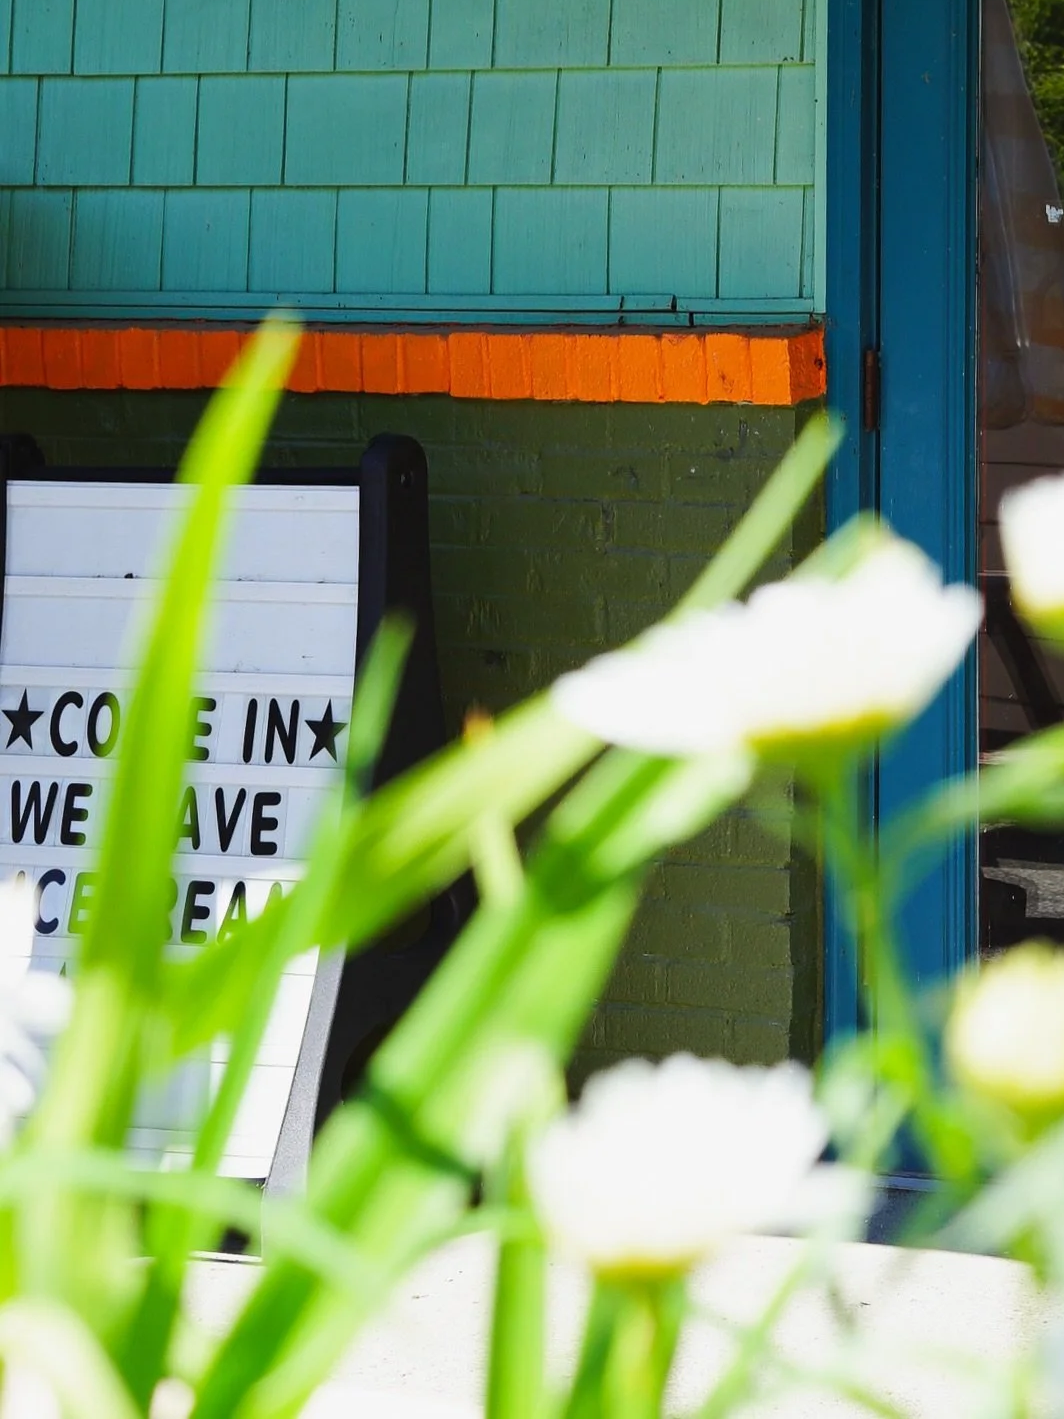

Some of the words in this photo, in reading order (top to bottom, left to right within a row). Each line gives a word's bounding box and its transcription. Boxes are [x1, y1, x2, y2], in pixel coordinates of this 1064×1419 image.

[49, 690, 217, 762] COE
[242, 697, 300, 764] IN
[10, 779, 93, 846] WE
[167, 785, 282, 856] AVE
[14, 868, 101, 935] CE
